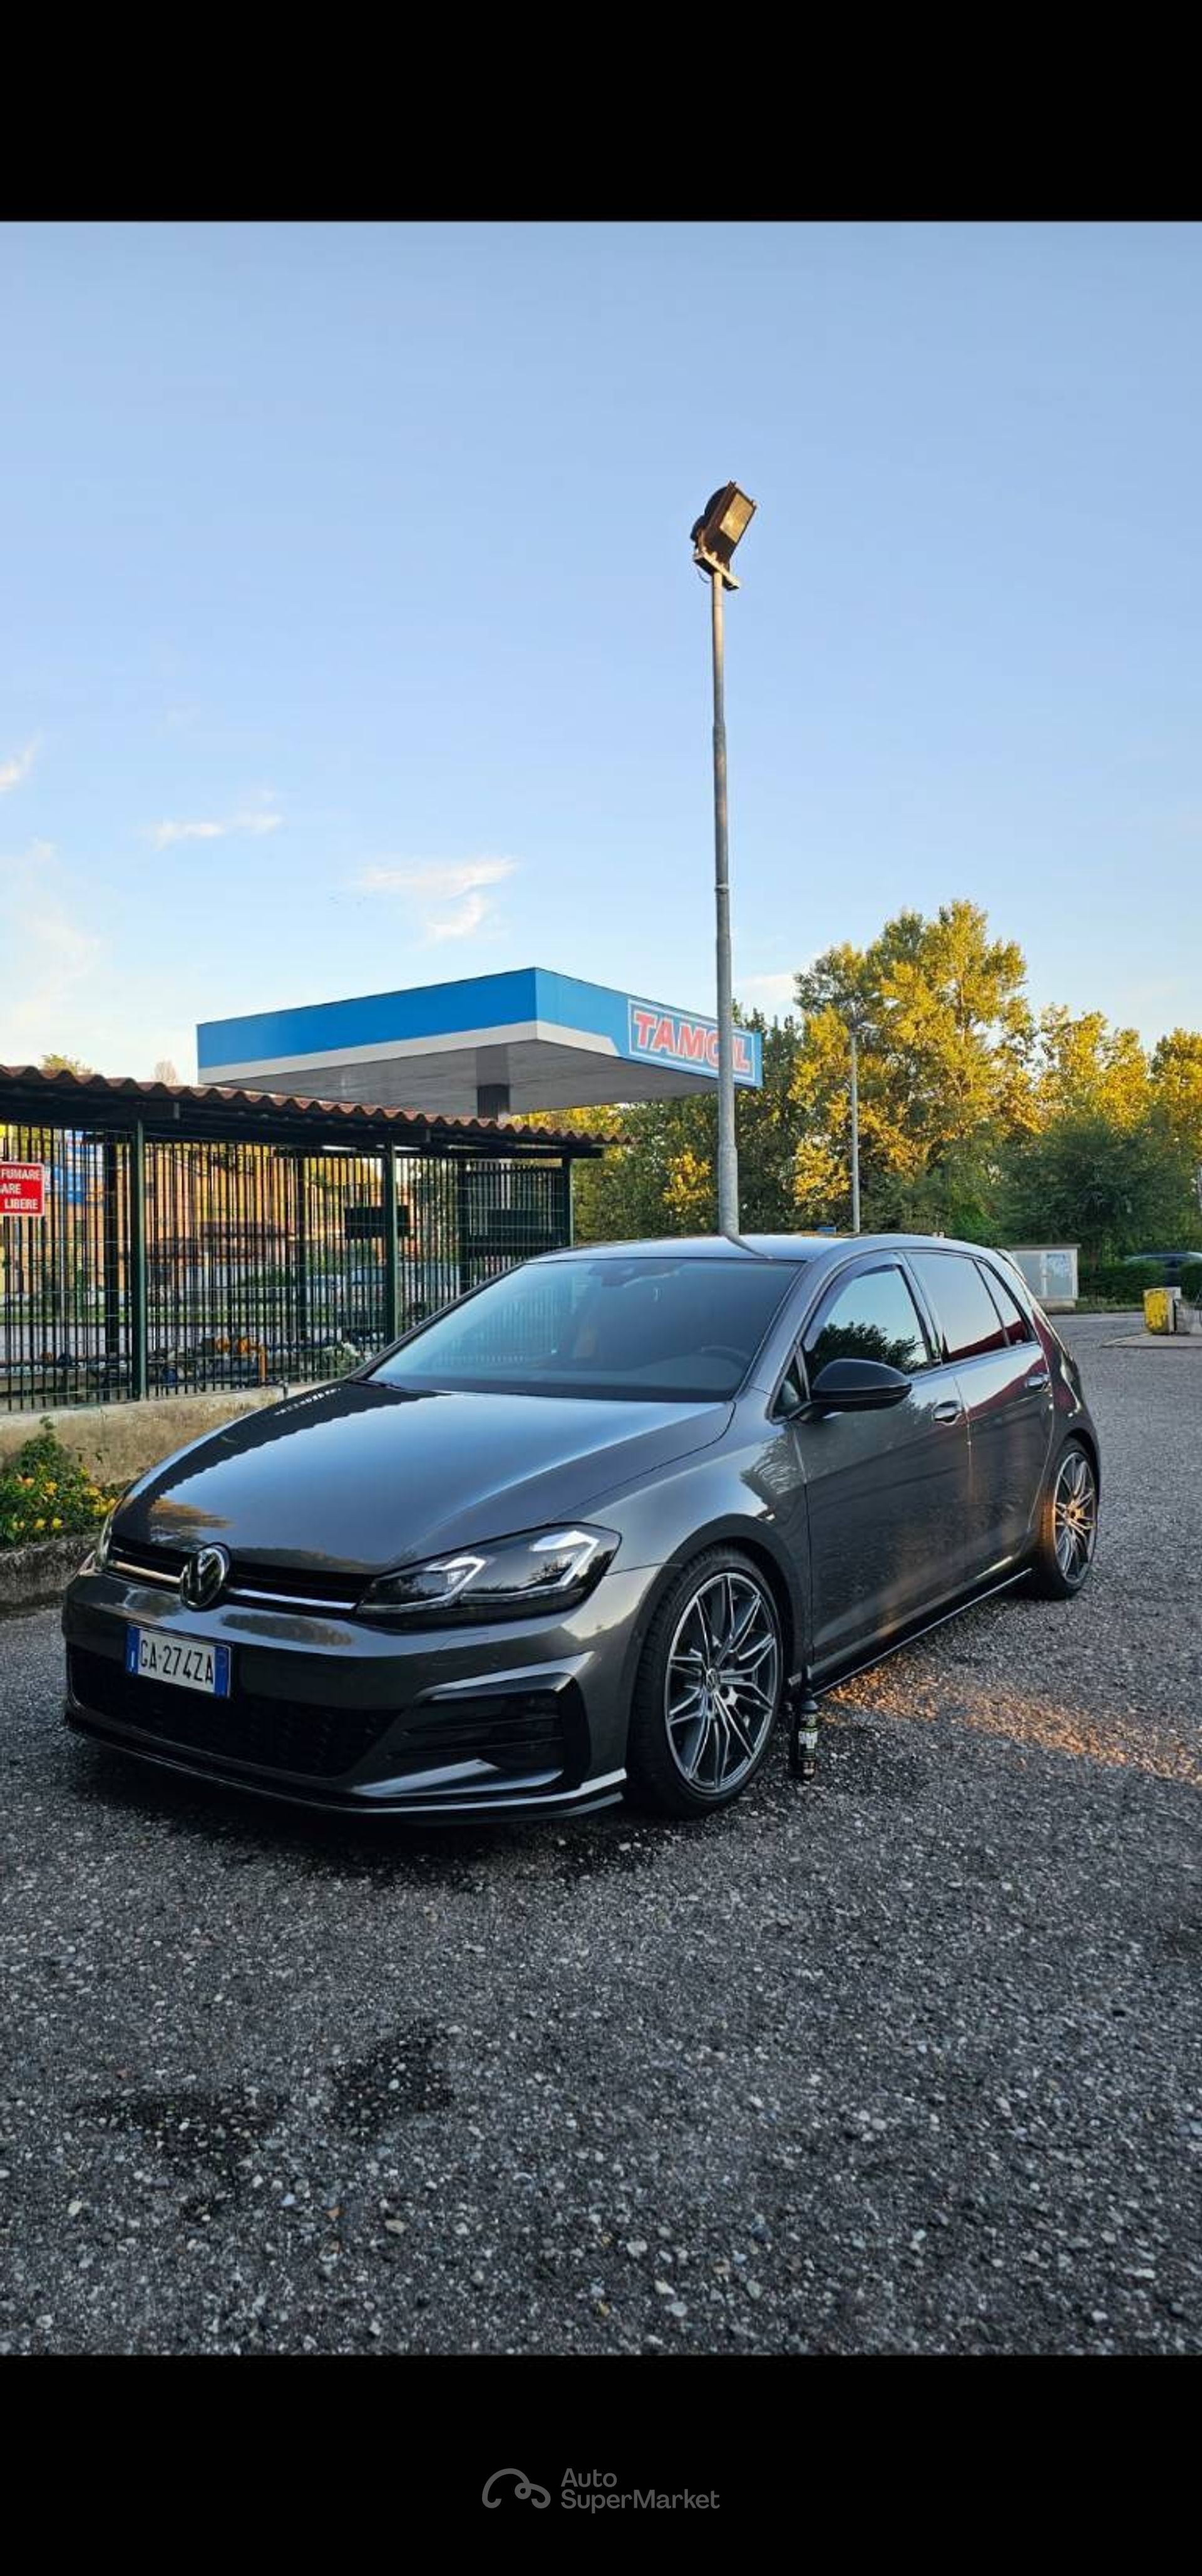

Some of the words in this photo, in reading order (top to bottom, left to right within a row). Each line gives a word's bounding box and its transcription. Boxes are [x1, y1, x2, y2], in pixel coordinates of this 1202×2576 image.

[634, 1010, 751, 1073] TAMOL
[1, 1168, 41, 1181] FUMARE
[0, 1183, 21, 1194] ARE
[4, 1198, 38, 1209] LIBERE
